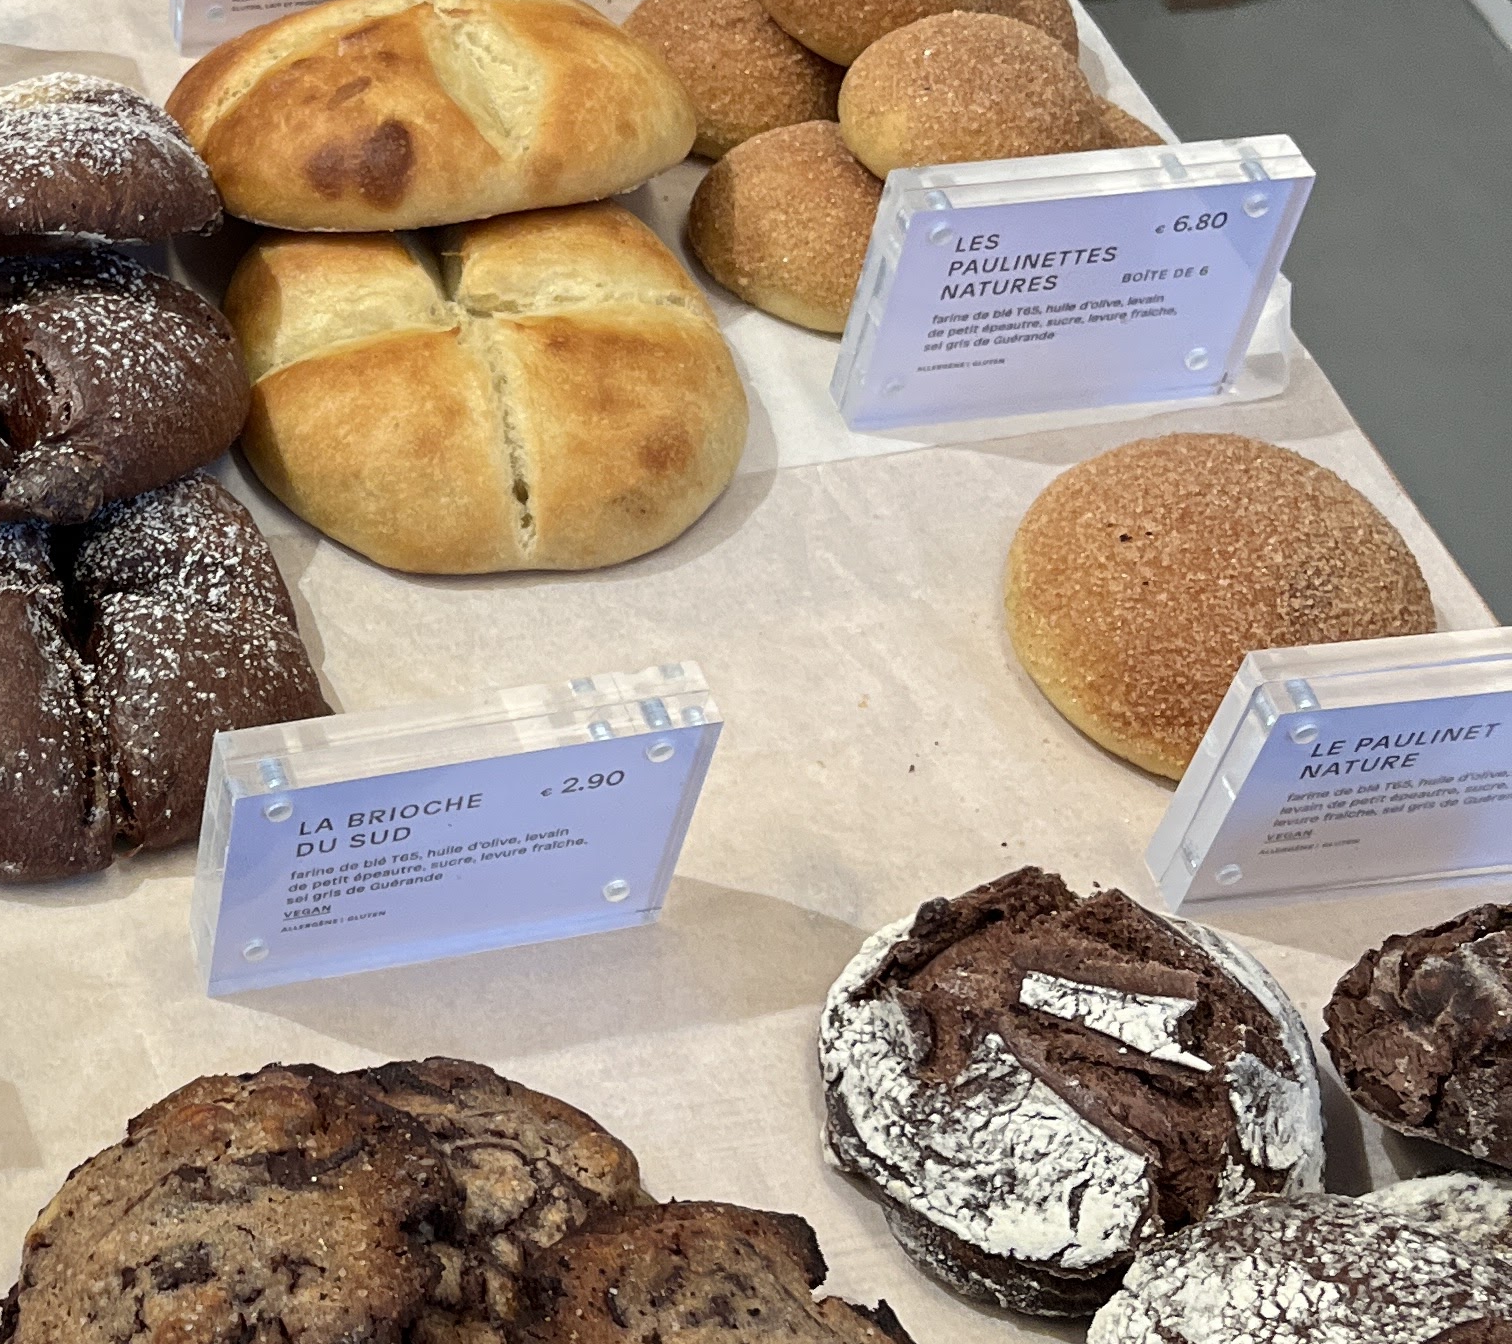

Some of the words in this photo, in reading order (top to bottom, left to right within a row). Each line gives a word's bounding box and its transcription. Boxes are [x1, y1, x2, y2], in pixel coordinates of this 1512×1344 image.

[955, 233, 1000, 253] LES
[1155, 224, 1166, 234] €
[1173, 211, 1228, 233] 6.80
[948, 246, 1119, 277] PAULINETTES
[939, 274, 1059, 301] NATURES
[1173, 266, 1194, 279] DE
[1199, 265, 1209, 277] 6
[1310, 739, 1347, 759] LE
[1353, 722, 1502, 754] PAULINET
[1299, 752, 1421, 780] NATURE
[298, 815, 336, 837] LA
[347, 792, 486, 830] BRIOCHE
[540, 788, 554, 799] €
[560, 769, 626, 795] 2.90
[290, 866, 335, 881] farine
[338, 862, 359, 872] de
[362, 855, 387, 869] blé
[426, 845, 464, 858] huile
[524, 827, 570, 843] levain
[296, 838, 338, 859] DU
[349, 825, 414, 851] SUD
[287, 882, 308, 893] de
[311, 875, 350, 891] petit
[479, 846, 527, 862] levure
[286, 892, 309, 905] sel
[311, 888, 341, 903] gris
[345, 885, 366, 895] de
[369, 872, 443, 891] Guérande
[282, 904, 332, 921] VEGAN
